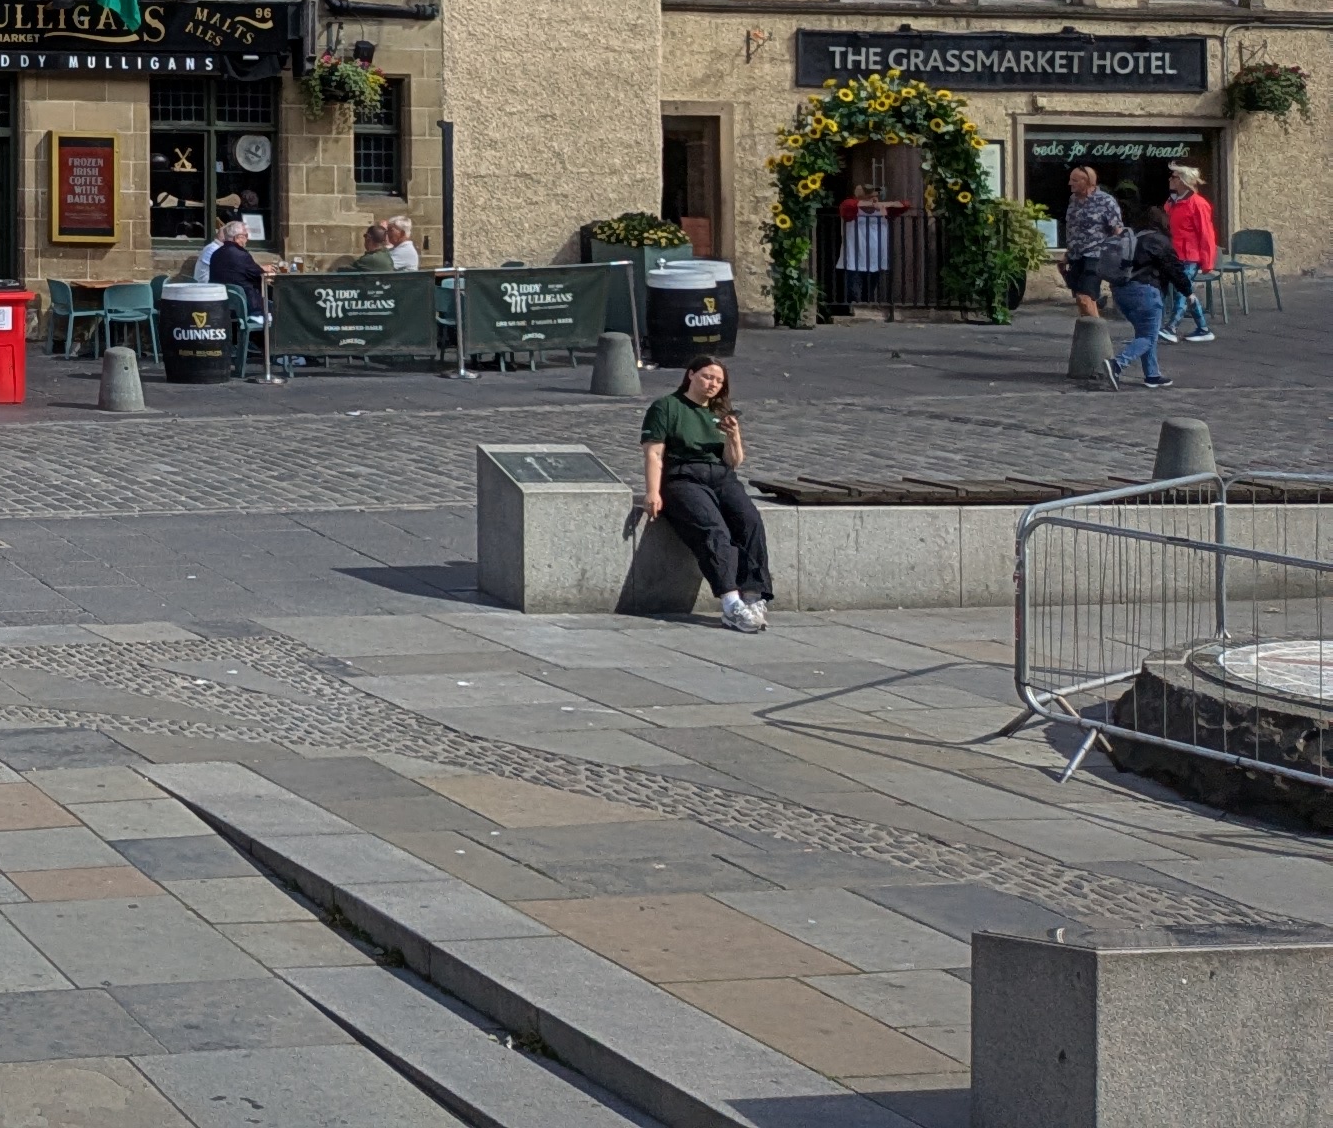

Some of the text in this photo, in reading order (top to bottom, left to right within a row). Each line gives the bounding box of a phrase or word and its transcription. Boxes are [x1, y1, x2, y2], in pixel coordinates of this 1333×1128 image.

[254, 7, 273, 19] 96
[194, 6, 257, 45] MALTS
[184, 22, 224, 48] ALES
[68, 55, 215, 71] MULLIGANS
[828, 46, 1178, 75] THE GRASSMARKET HOTEL
[1091, 142, 1144, 160] sleepy
[68, 158, 104, 167] FROZEN
[73, 167, 99, 176] IRISH
[69, 176, 103, 185] COFFEE
[74, 186, 98, 194] WITH
[66, 195, 106, 204] BAILEYS
[314, 288, 360, 308] BIDDY
[500, 282, 542, 303] BIDDY
[325, 299, 396, 319] MULLIGANS
[510, 292, 574, 313] MULLIGANS
[173, 327, 227, 341] GUINNESS
